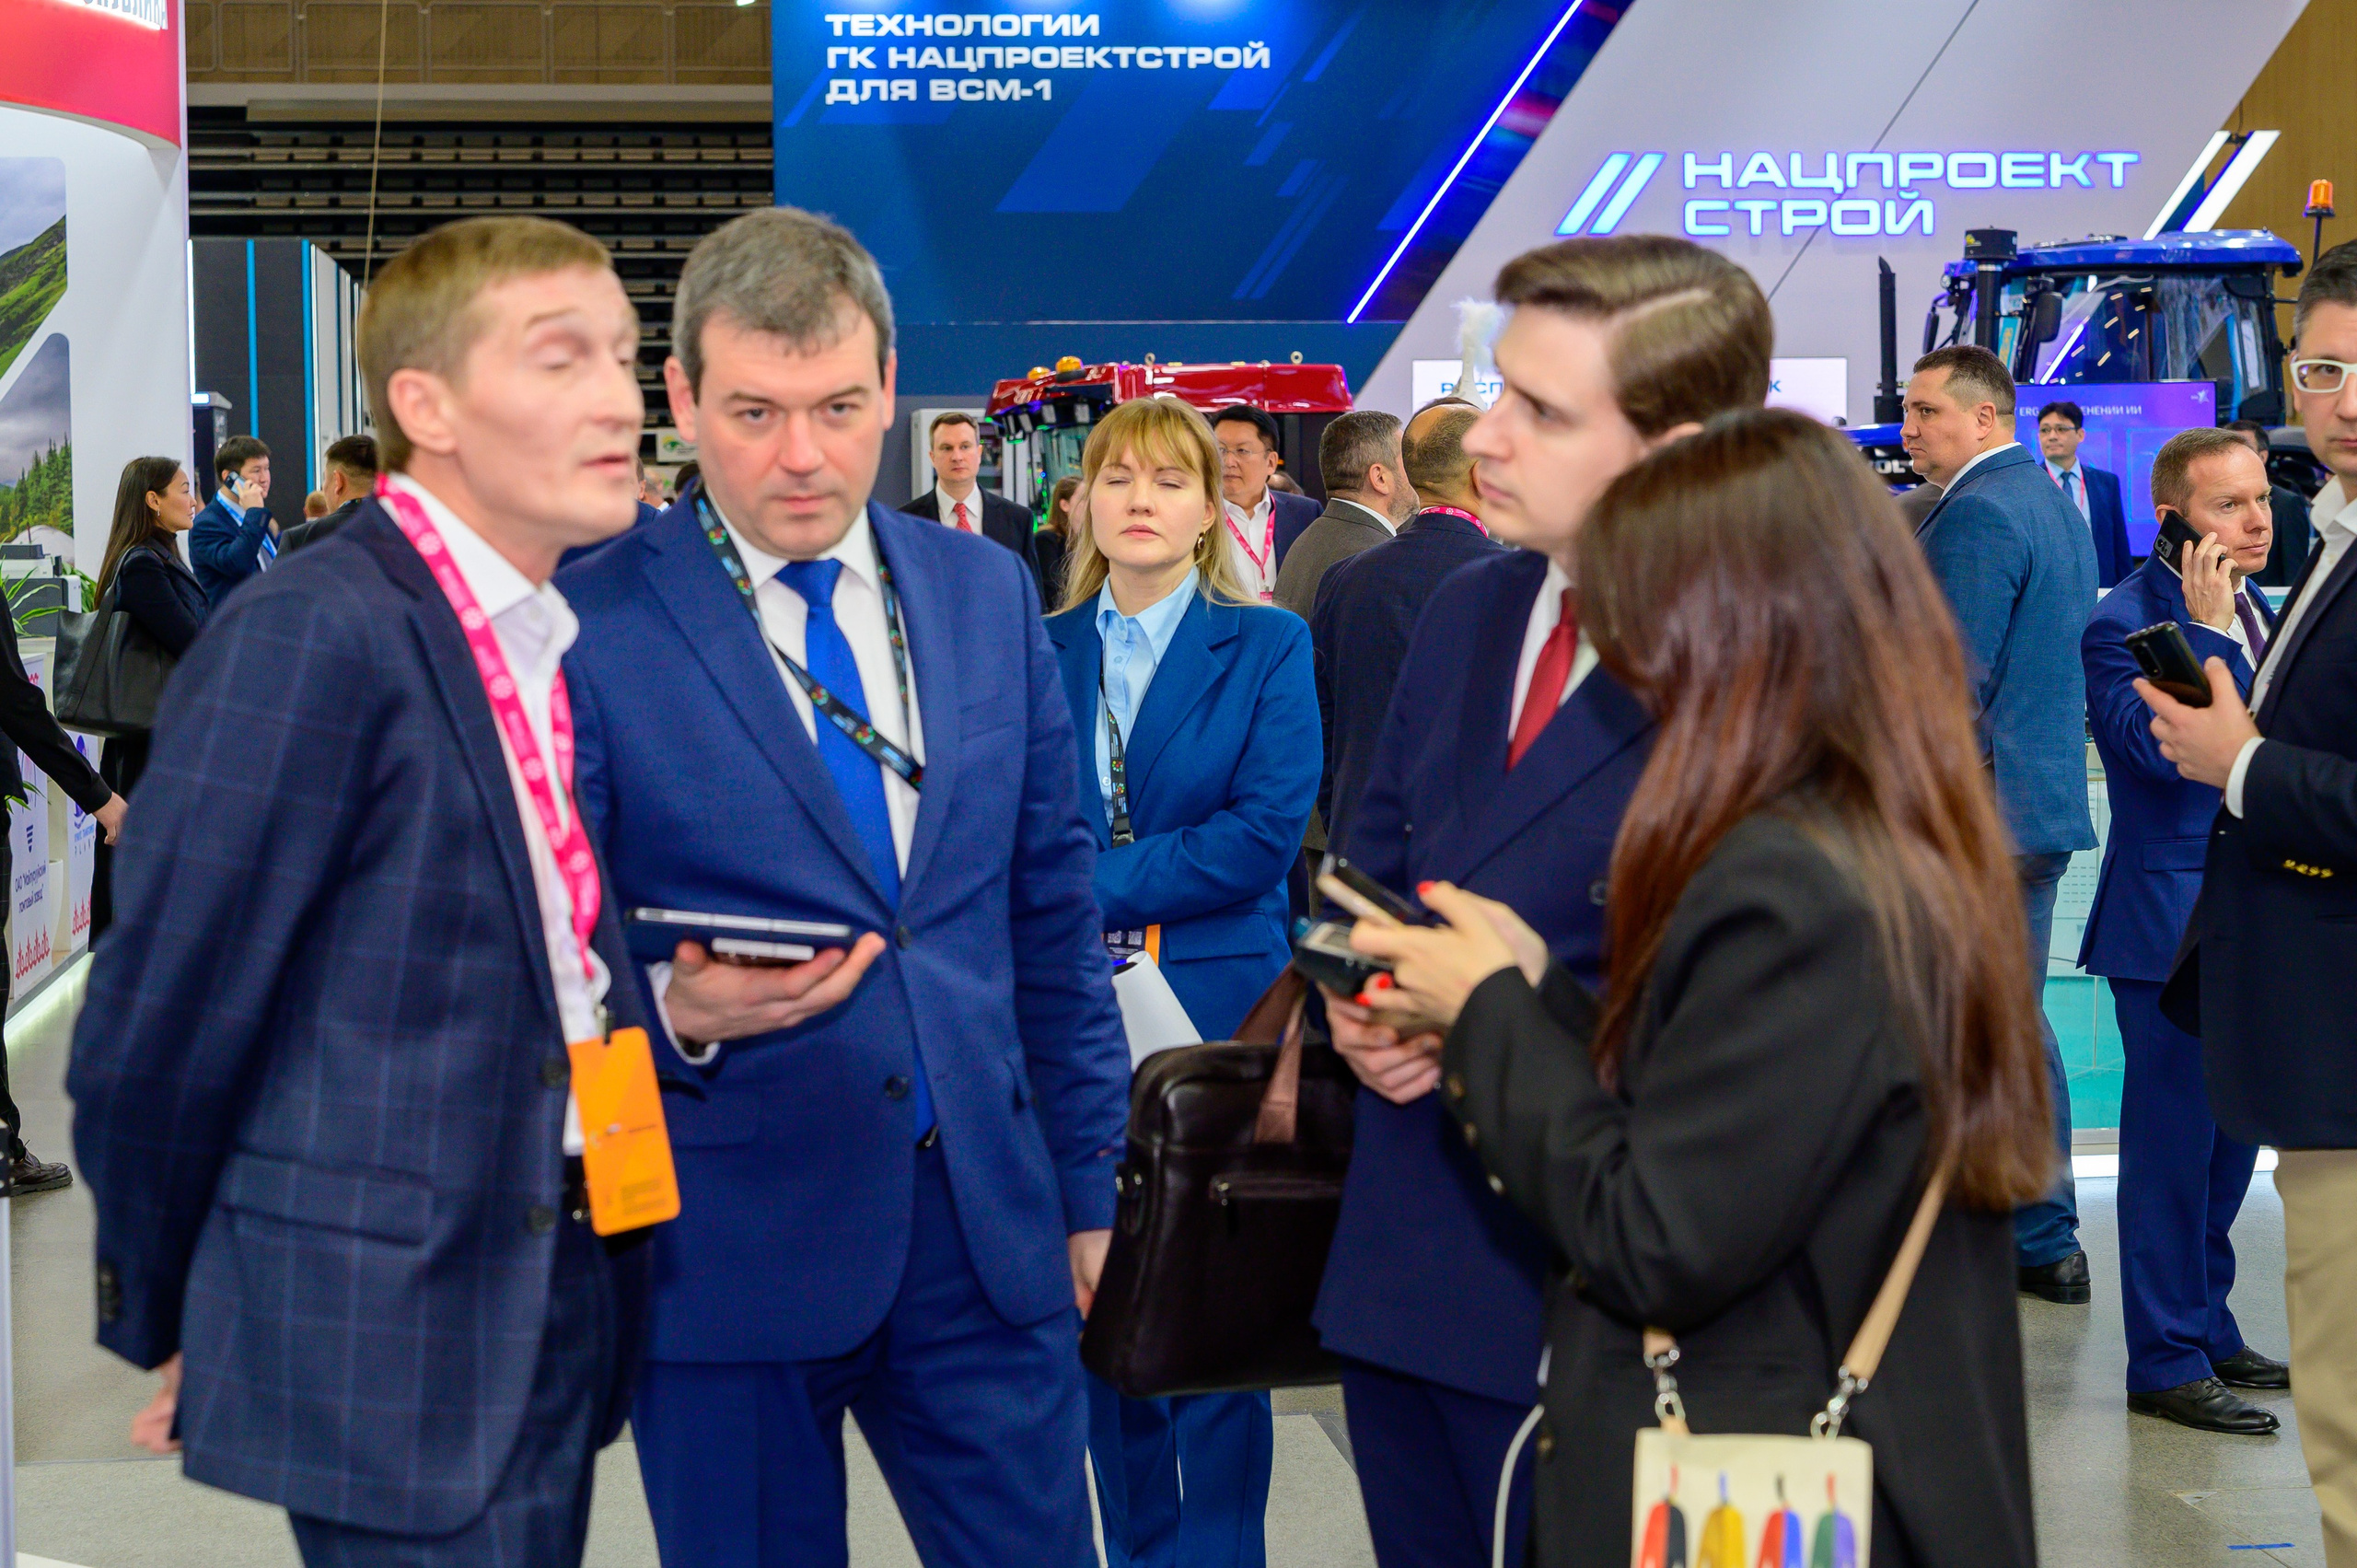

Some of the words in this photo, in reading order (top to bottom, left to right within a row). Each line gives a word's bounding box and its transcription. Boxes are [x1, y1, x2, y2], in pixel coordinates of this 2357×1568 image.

[825, 13, 1100, 37] ТЕХНОЛОГИИ
[828, 46, 877, 70] ГК
[888, 41, 1271, 73] НАЦПРОЕКТСТРОЙ
[825, 78, 918, 105] ДЛЯ
[929, 78, 1052, 102] ВСМ-1
[1682, 151, 2141, 194] НАЦПРОЕКТ
[1682, 189, 1935, 237] СТРОЙ
[2081, 405, 2124, 416] ЕНЕНИИ
